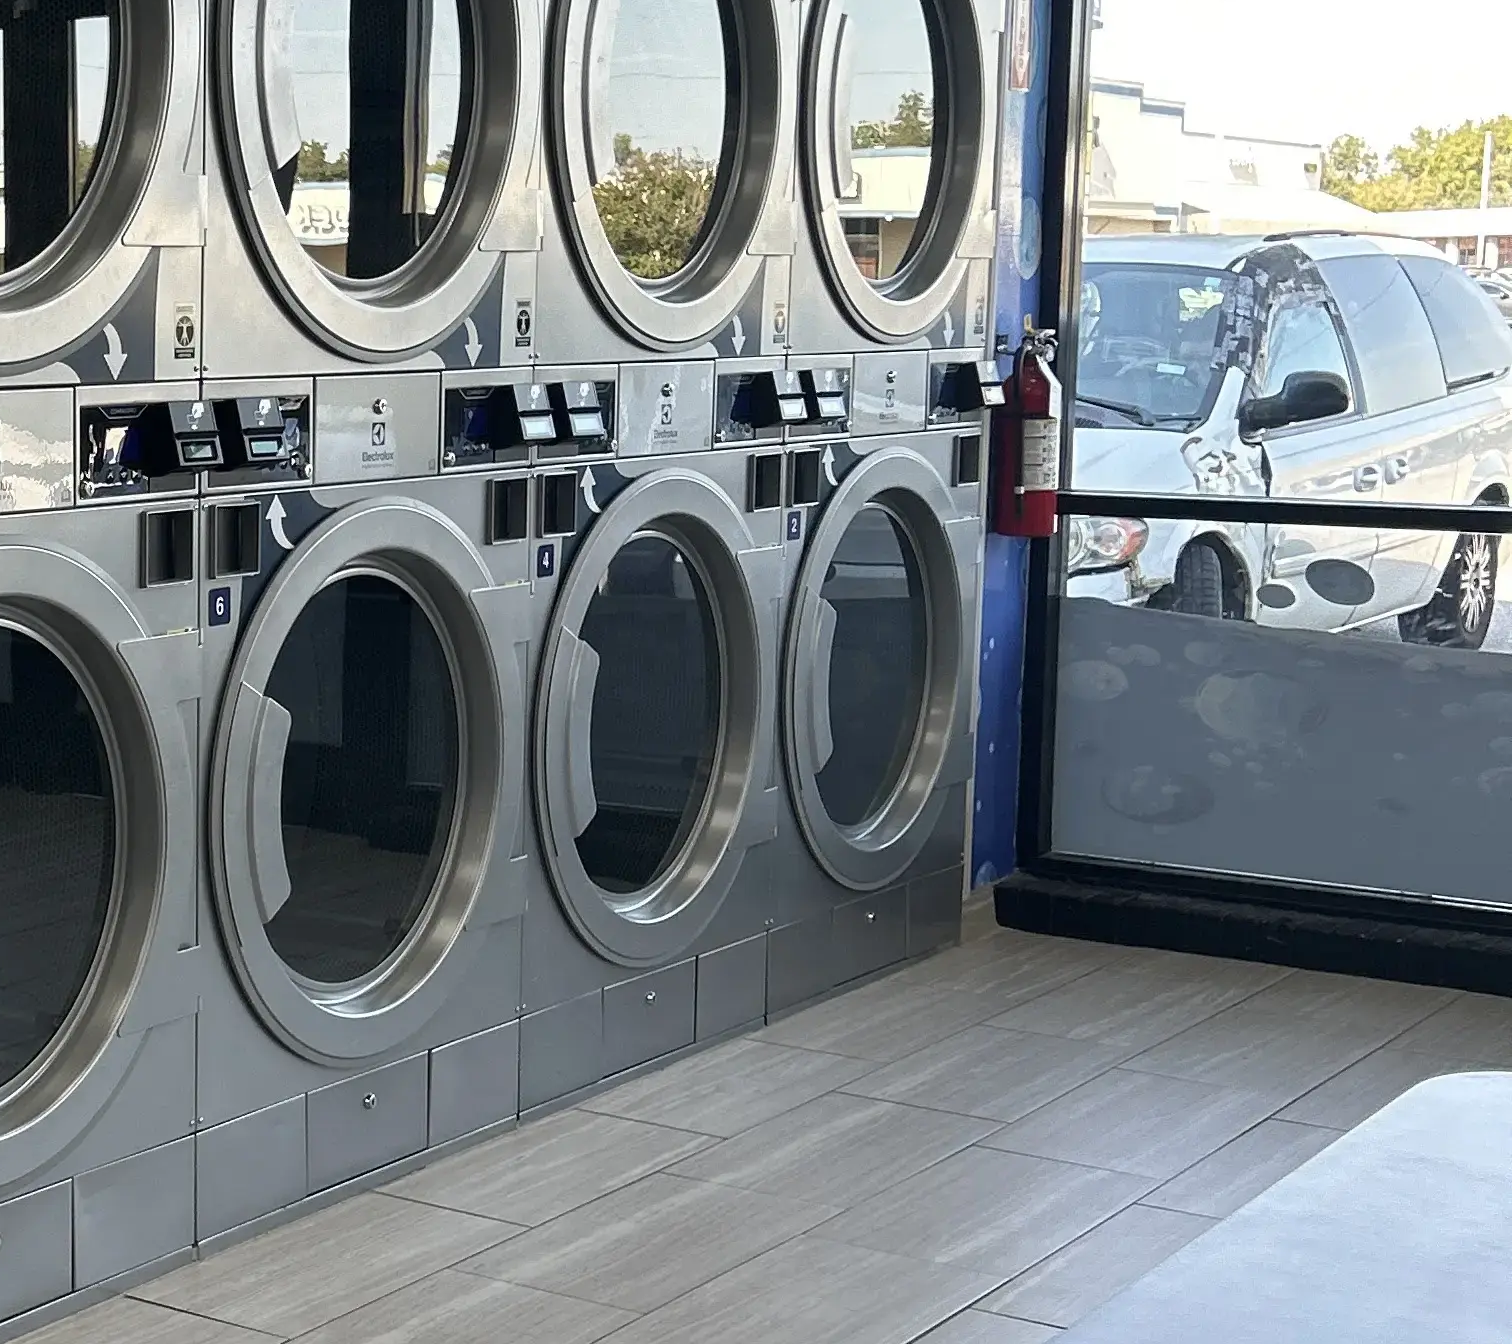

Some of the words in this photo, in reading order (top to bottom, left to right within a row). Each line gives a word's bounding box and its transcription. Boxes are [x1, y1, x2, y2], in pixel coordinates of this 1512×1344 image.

[791, 517, 798, 533] 2
[542, 551, 550, 568] 4
[215, 596, 224, 616] 6
